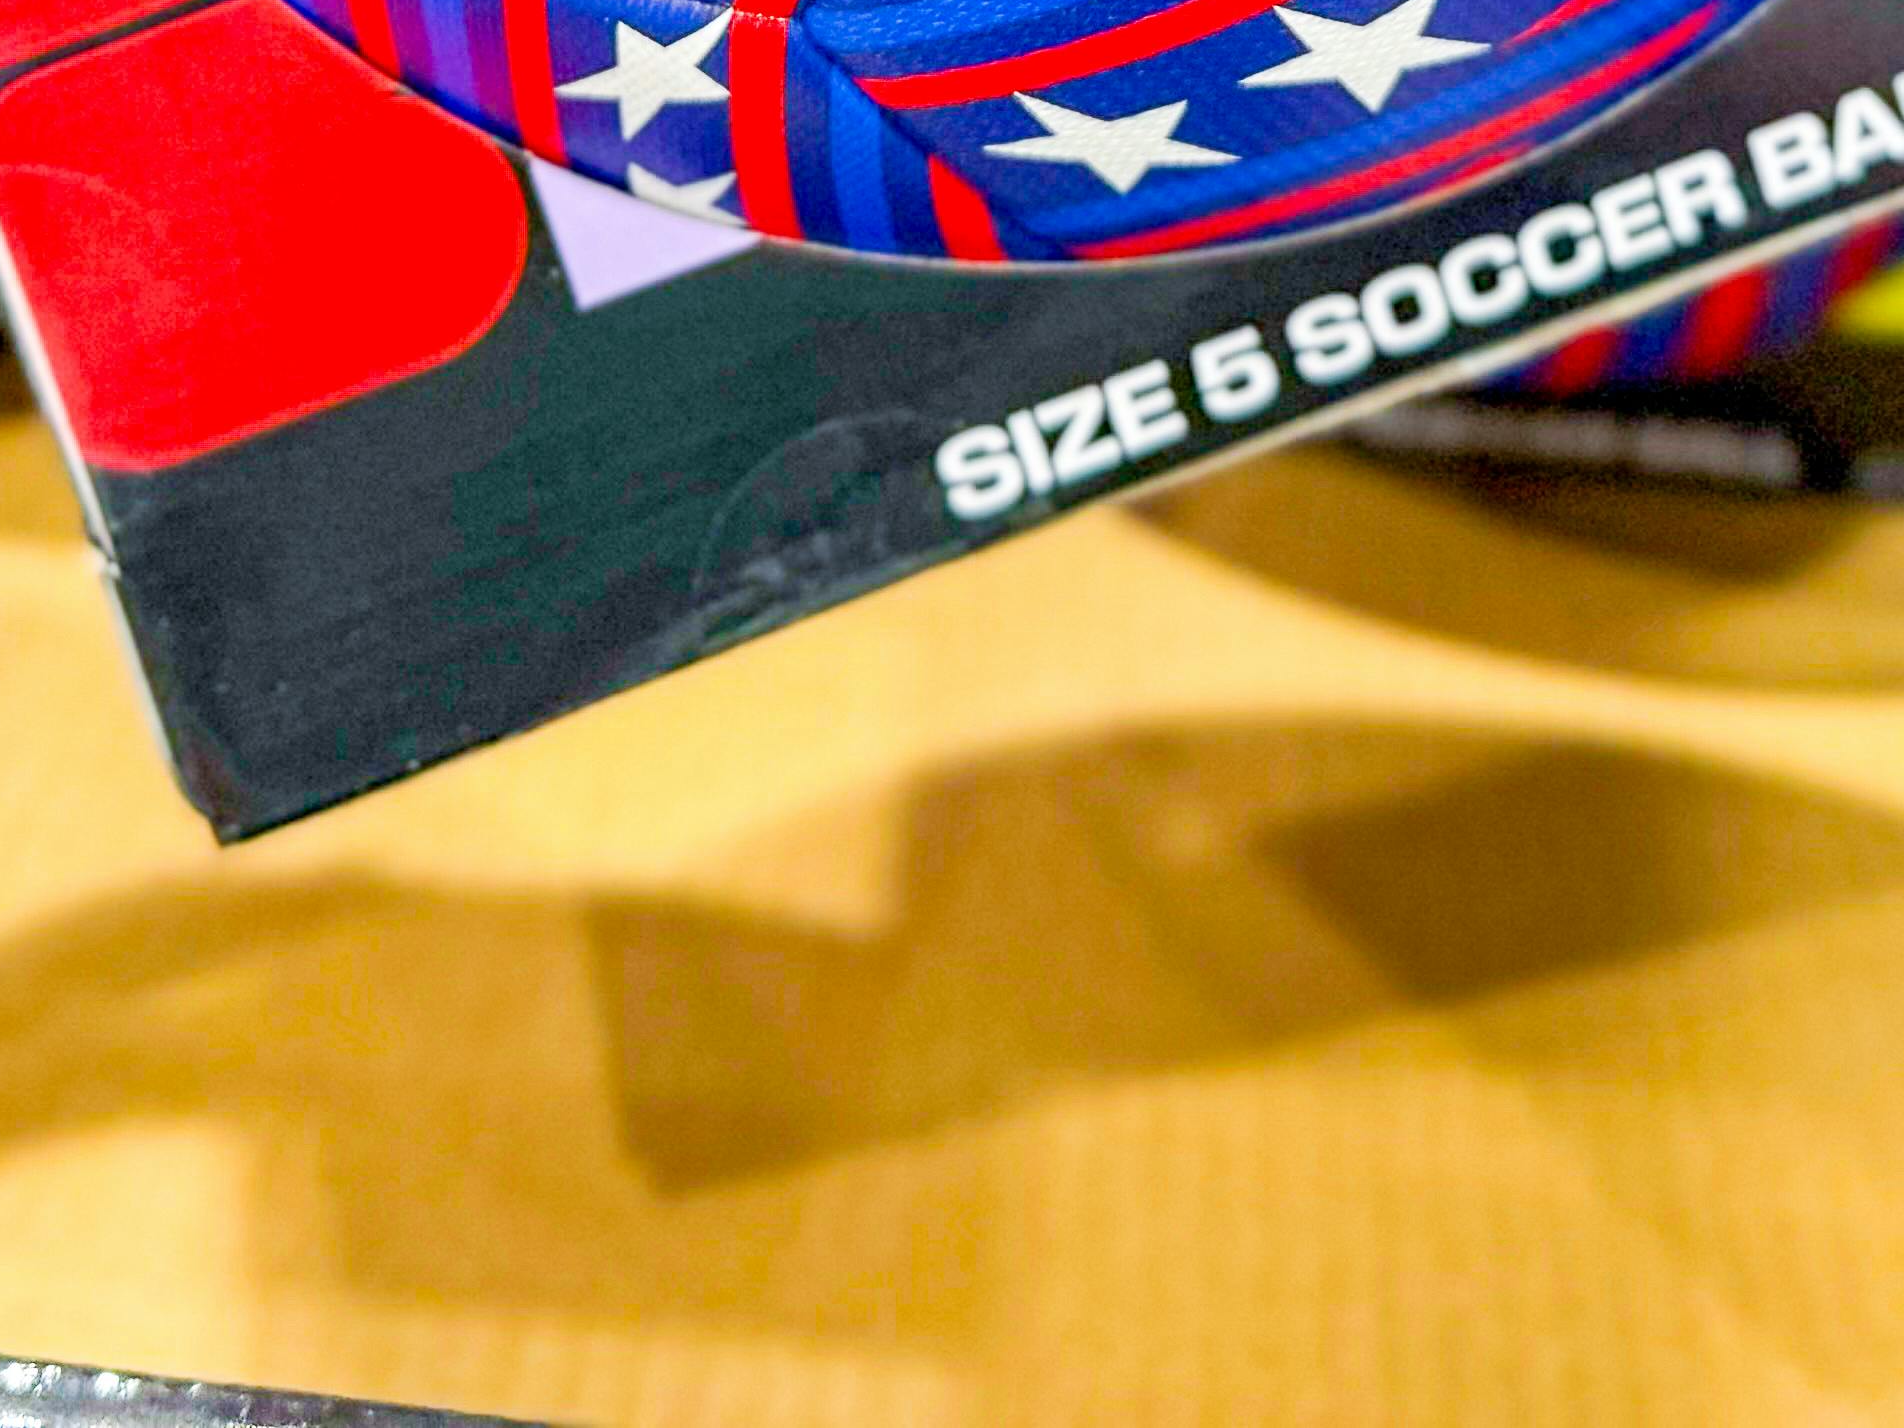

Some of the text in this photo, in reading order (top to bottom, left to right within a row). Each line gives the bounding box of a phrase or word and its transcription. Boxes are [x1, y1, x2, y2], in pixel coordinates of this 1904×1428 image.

[935, 358, 1189, 520] SIZE
[1191, 324, 1281, 423] 5
[1284, 149, 1747, 384] SOCCER
